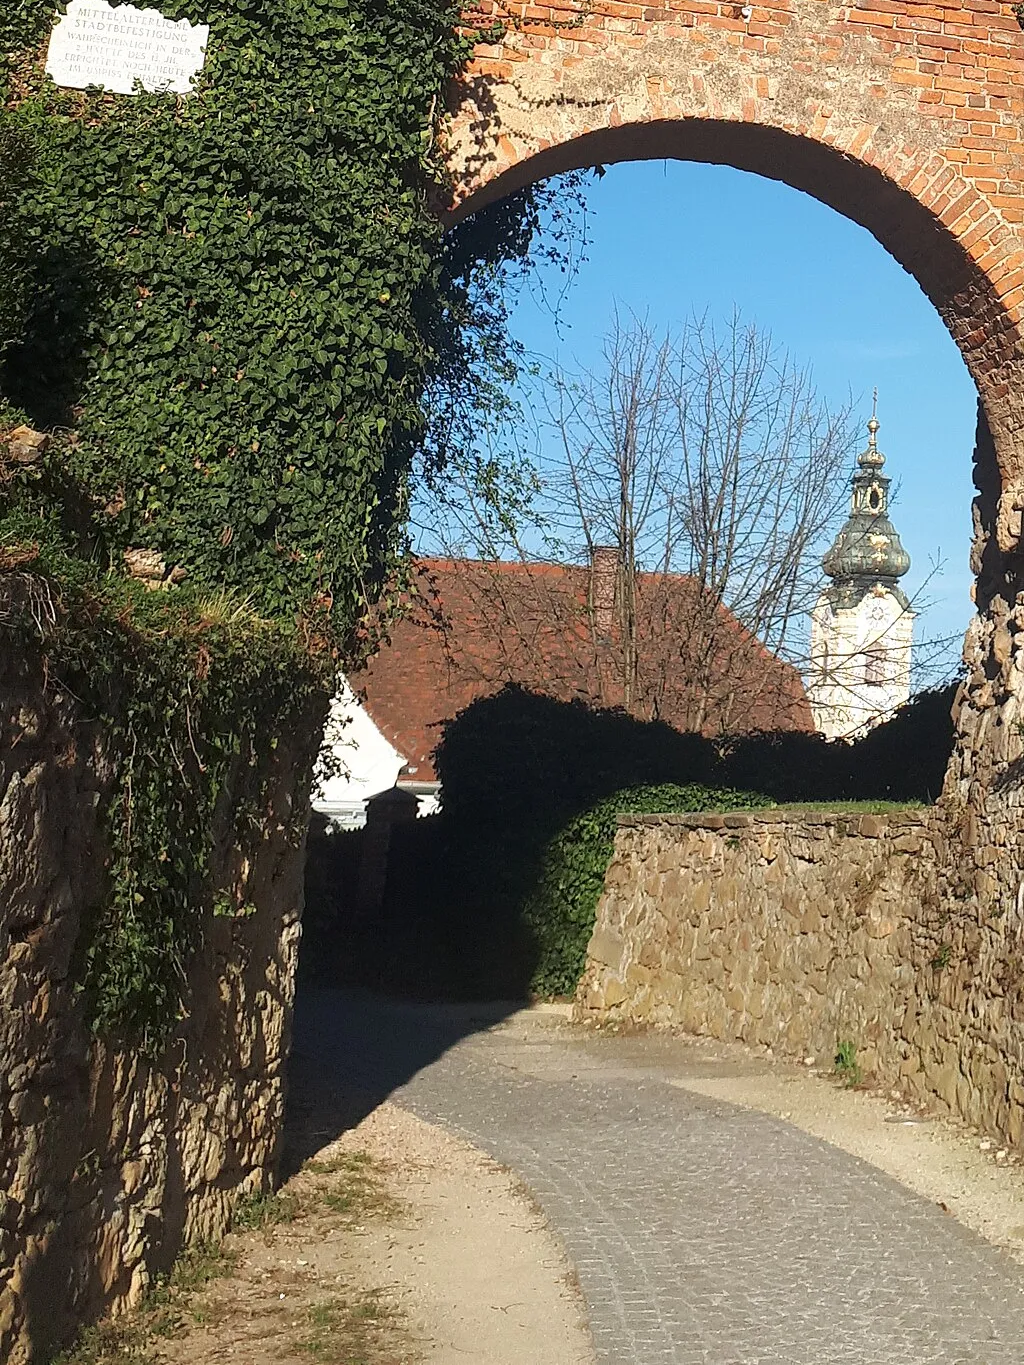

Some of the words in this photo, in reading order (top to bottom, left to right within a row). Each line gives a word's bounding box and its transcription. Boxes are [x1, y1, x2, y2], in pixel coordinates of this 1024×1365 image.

[75, 19, 188, 42] STADTBEFESTIGUNG
[78, 8, 188, 31] MITTELALTERLICHE
[67, 31, 151, 49] WAHRSCHEINLICH
[156, 44, 167, 52] IN
[172, 46, 191, 55] DER
[128, 51, 146, 60] DES
[122, 61, 151, 71] NOCH
[156, 65, 186, 77] HEUTE
